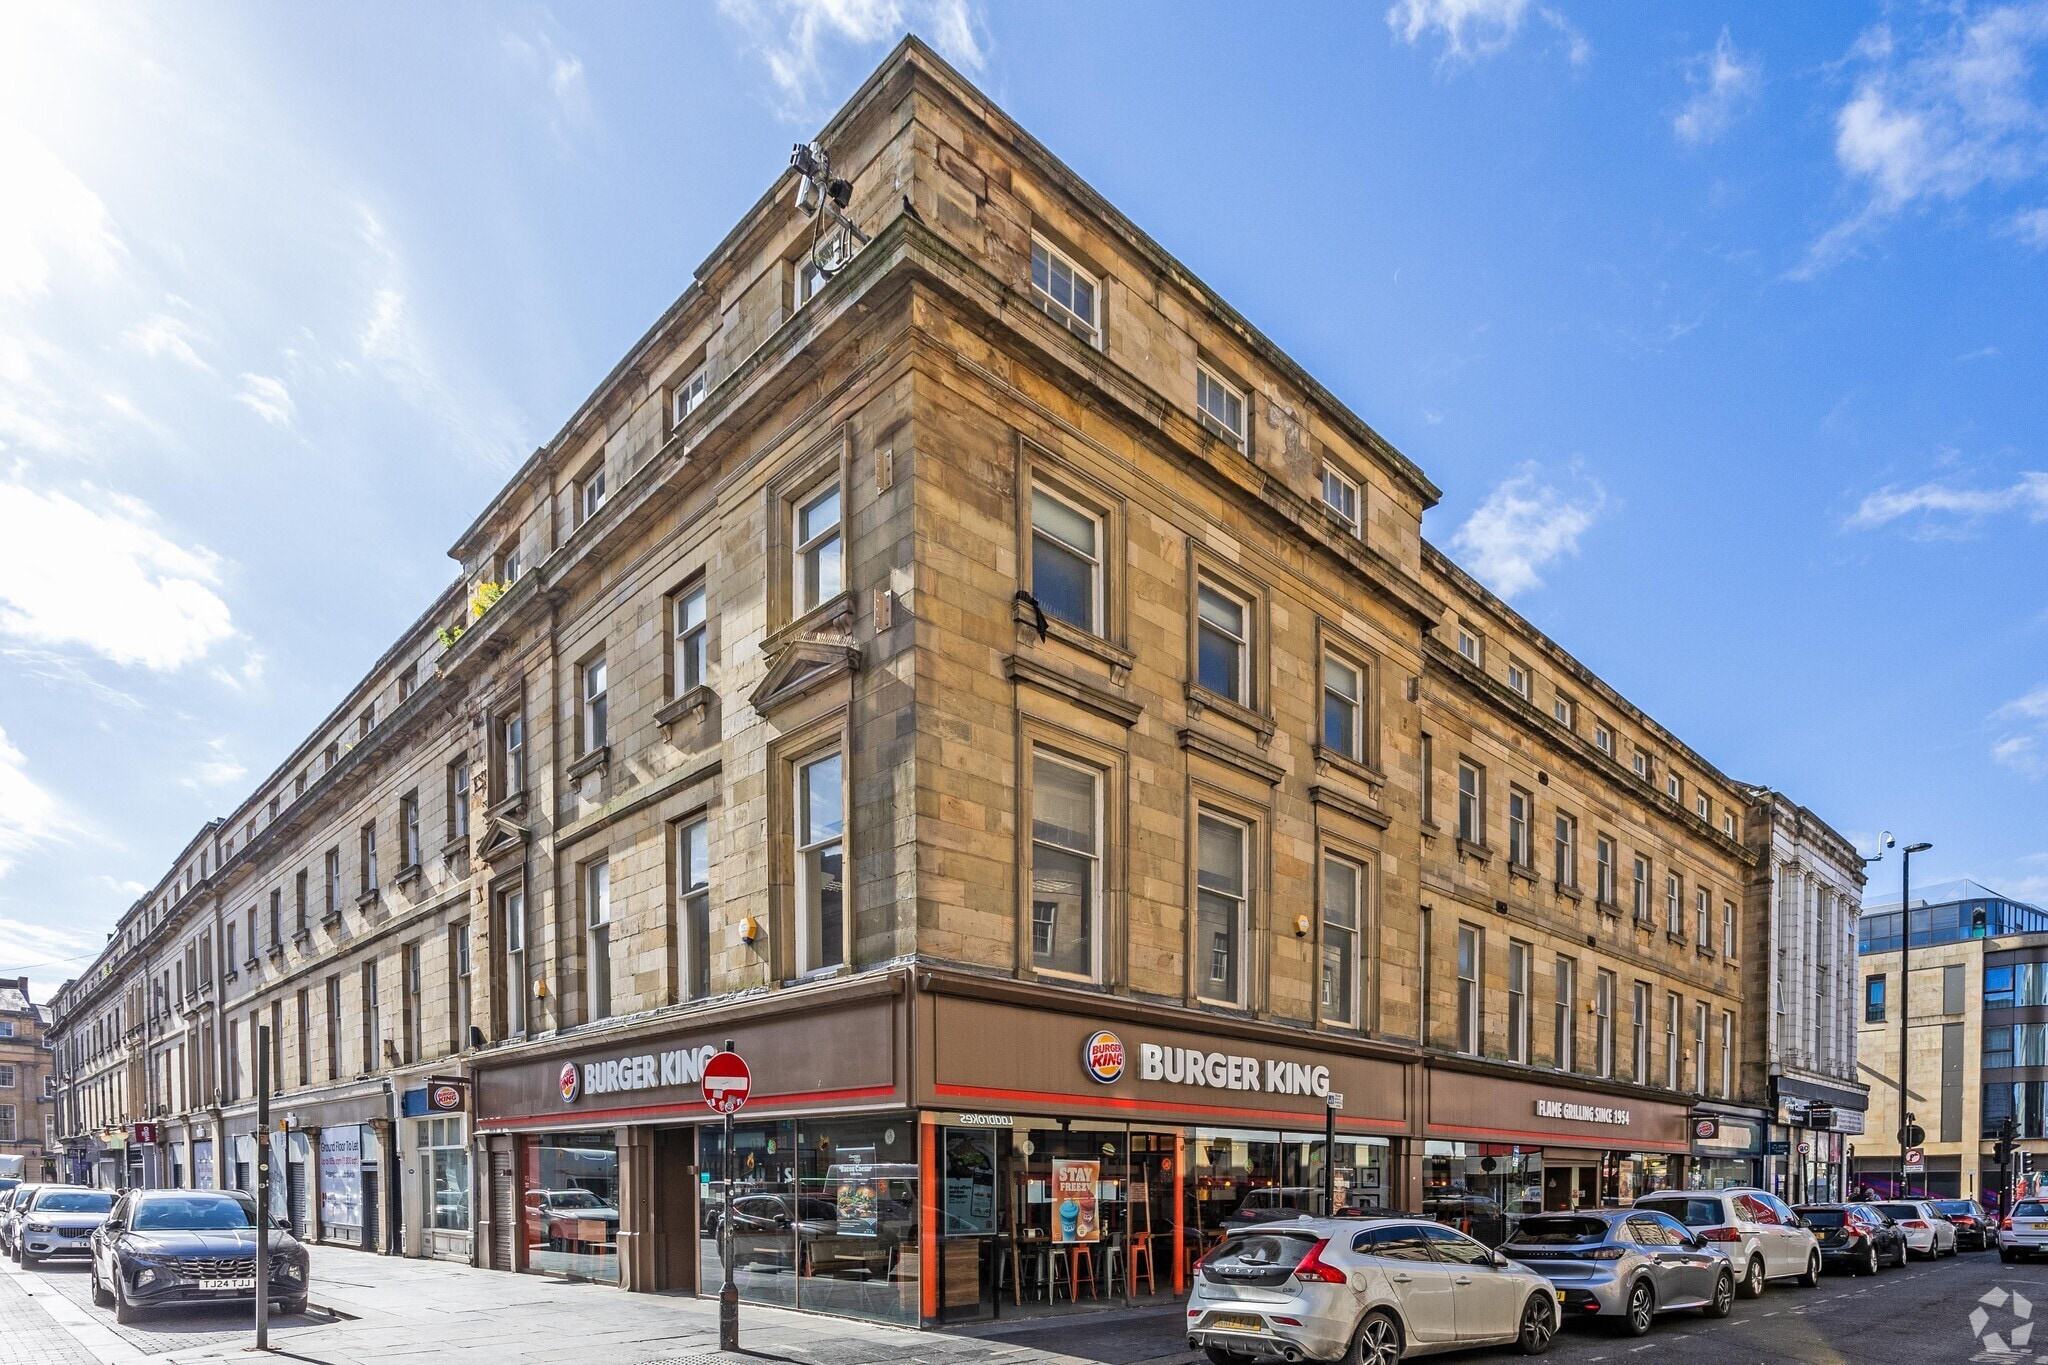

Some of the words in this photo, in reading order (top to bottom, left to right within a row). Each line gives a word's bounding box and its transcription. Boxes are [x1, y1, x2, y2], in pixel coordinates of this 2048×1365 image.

[1092, 1043, 1122, 1055] BURGER
[1092, 1052, 1123, 1068] KING
[584, 1054, 658, 1095] BURGER
[1141, 1043, 1260, 1092] BURGER
[1264, 1059, 1330, 1098] KING
[438, 1094, 457, 1103] KING
[1537, 1099, 1562, 1118] FLAME
[1563, 1102, 1593, 1122] GRILLING
[1594, 1106, 1613, 1124] SINCE
[1613, 1109, 1630, 1126] 1954
[321, 1142, 336, 1152] Ground
[336, 1141, 346, 1152] Floor
[1059, 1167, 1093, 1182] STAY
[1060, 1182, 1092, 1192] FREEZY
[203, 1280, 229, 1288] TJ24
[231, 1279, 251, 1287] TJJ
